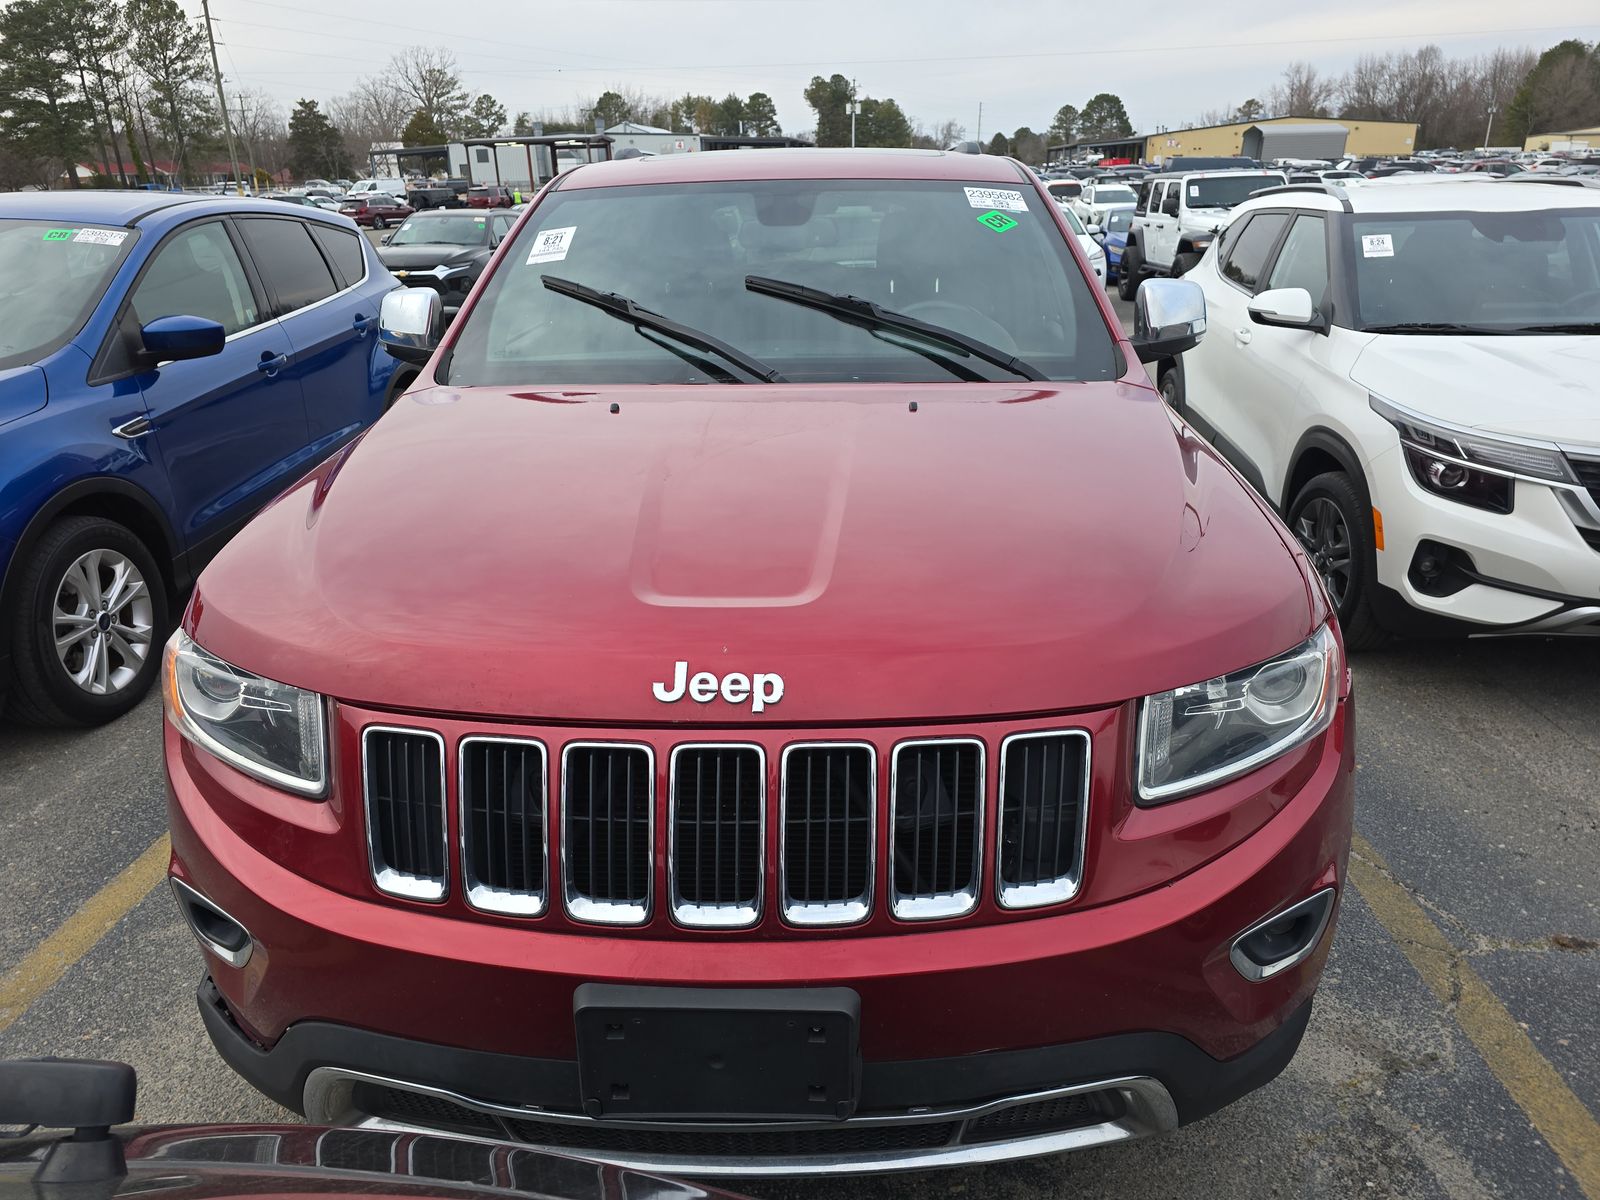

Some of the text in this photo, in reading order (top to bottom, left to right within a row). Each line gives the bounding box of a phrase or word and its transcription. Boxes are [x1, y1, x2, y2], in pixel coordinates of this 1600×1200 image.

[967, 189, 1023, 201] 2395682
[985, 214, 1012, 228] CR
[47, 231, 68, 239] CR
[543, 235, 564, 245] 8:21
[652, 661, 785, 713] Jeep
